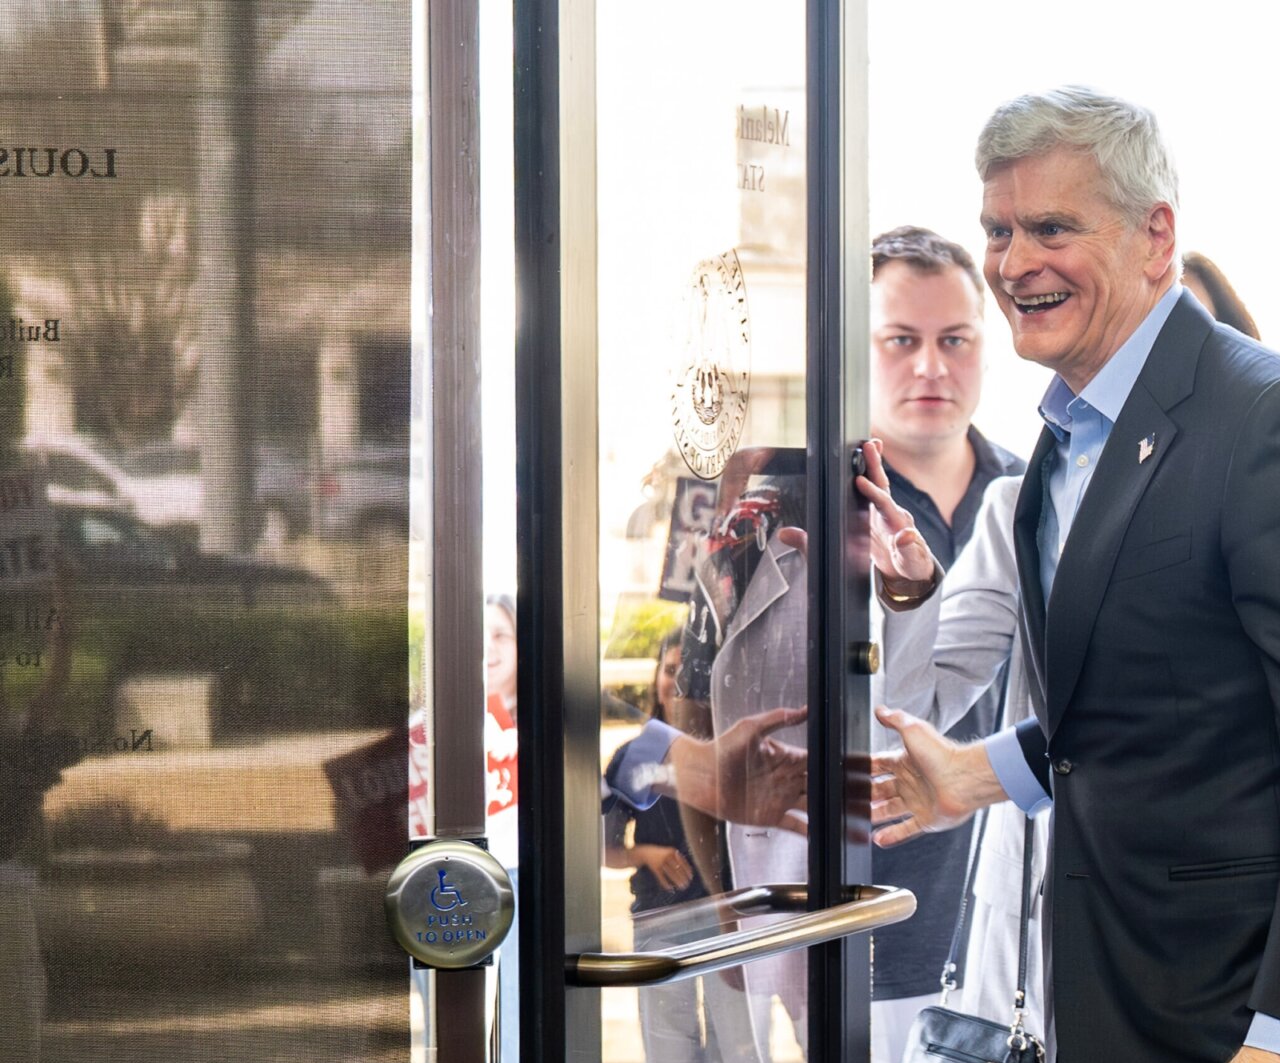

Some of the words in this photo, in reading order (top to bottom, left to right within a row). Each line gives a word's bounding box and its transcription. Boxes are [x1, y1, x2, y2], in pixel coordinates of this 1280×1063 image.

[428, 914, 472, 926] PUSH
[416, 931, 437, 943] TO
[443, 930, 486, 942] OPEN
